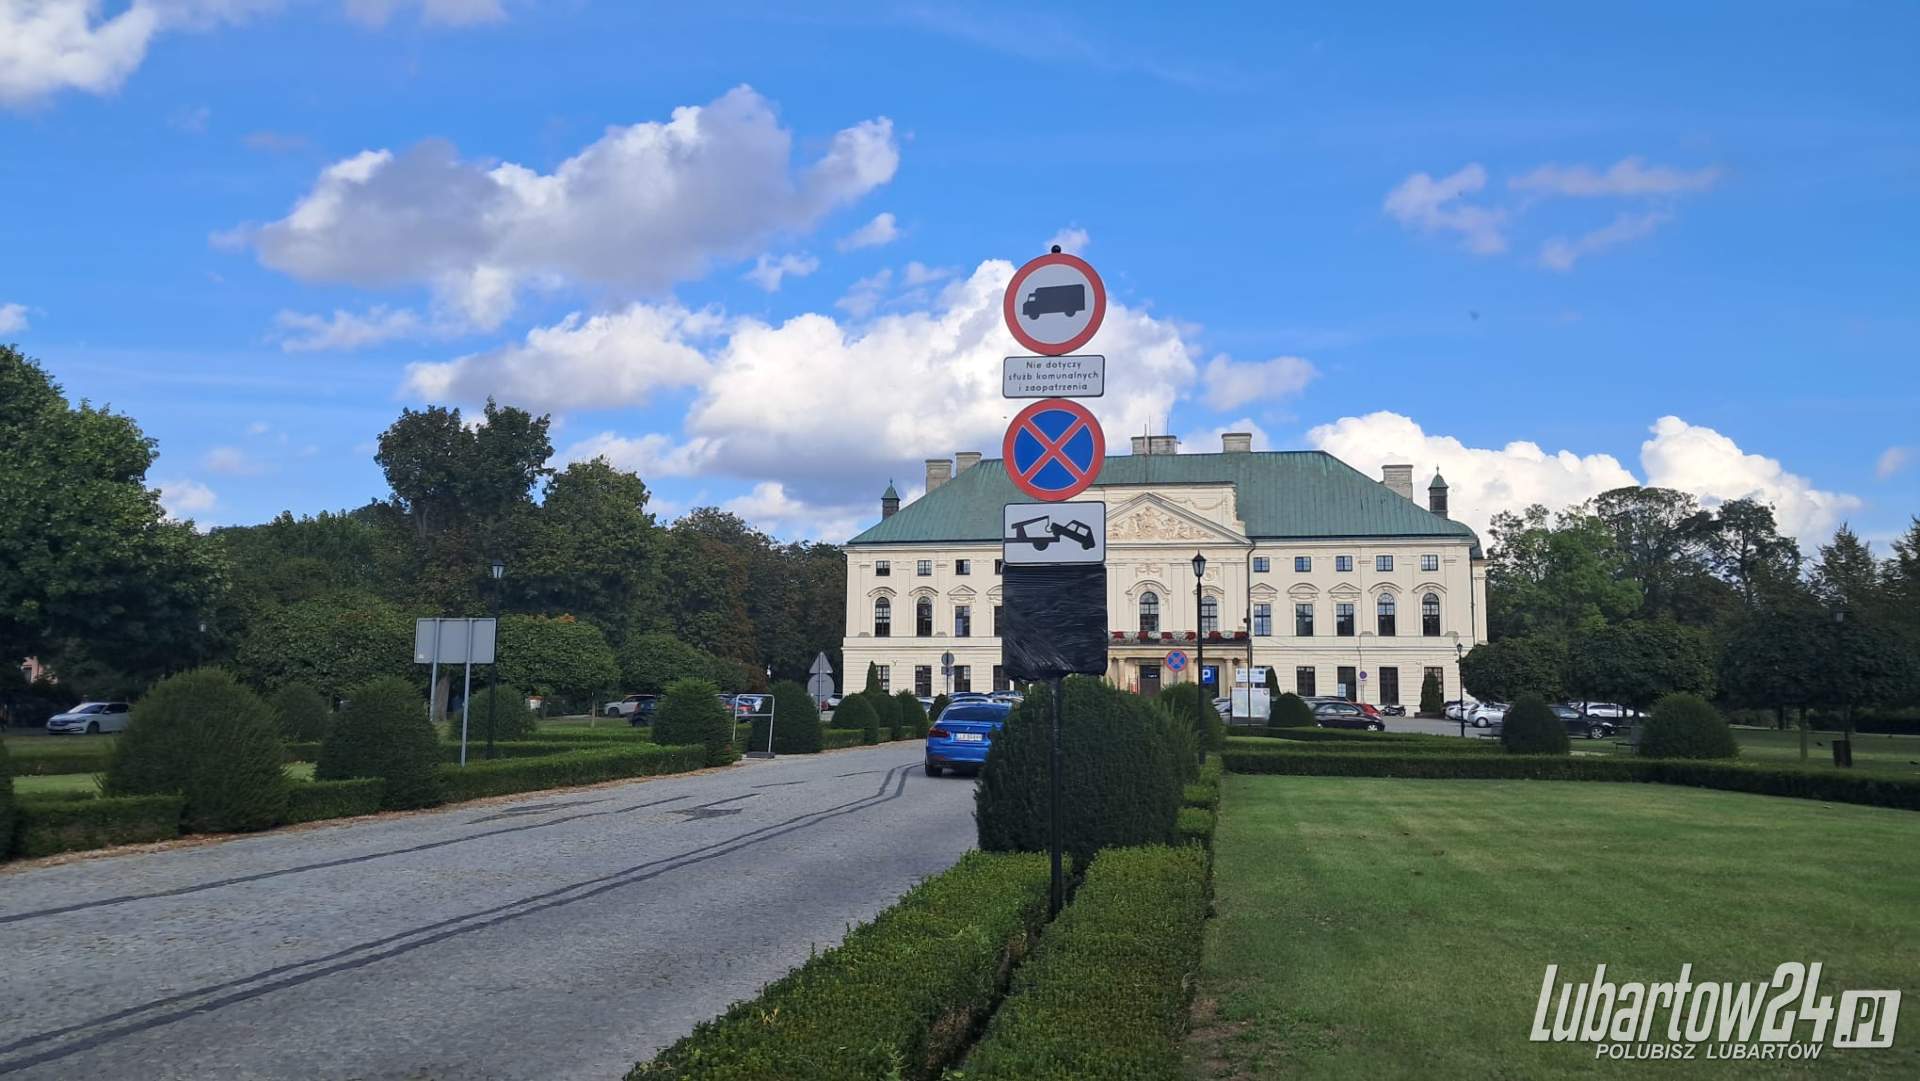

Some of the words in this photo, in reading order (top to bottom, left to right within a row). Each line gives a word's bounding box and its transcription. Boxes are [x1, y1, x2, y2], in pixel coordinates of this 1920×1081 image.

[1026, 361, 1042, 369] Nie
[1046, 360, 1081, 370] dotyczy
[1036, 371, 1099, 382] komunalnych
[1025, 384, 1087, 392] zaopatrzenia
[1202, 669, 1211, 681] P
